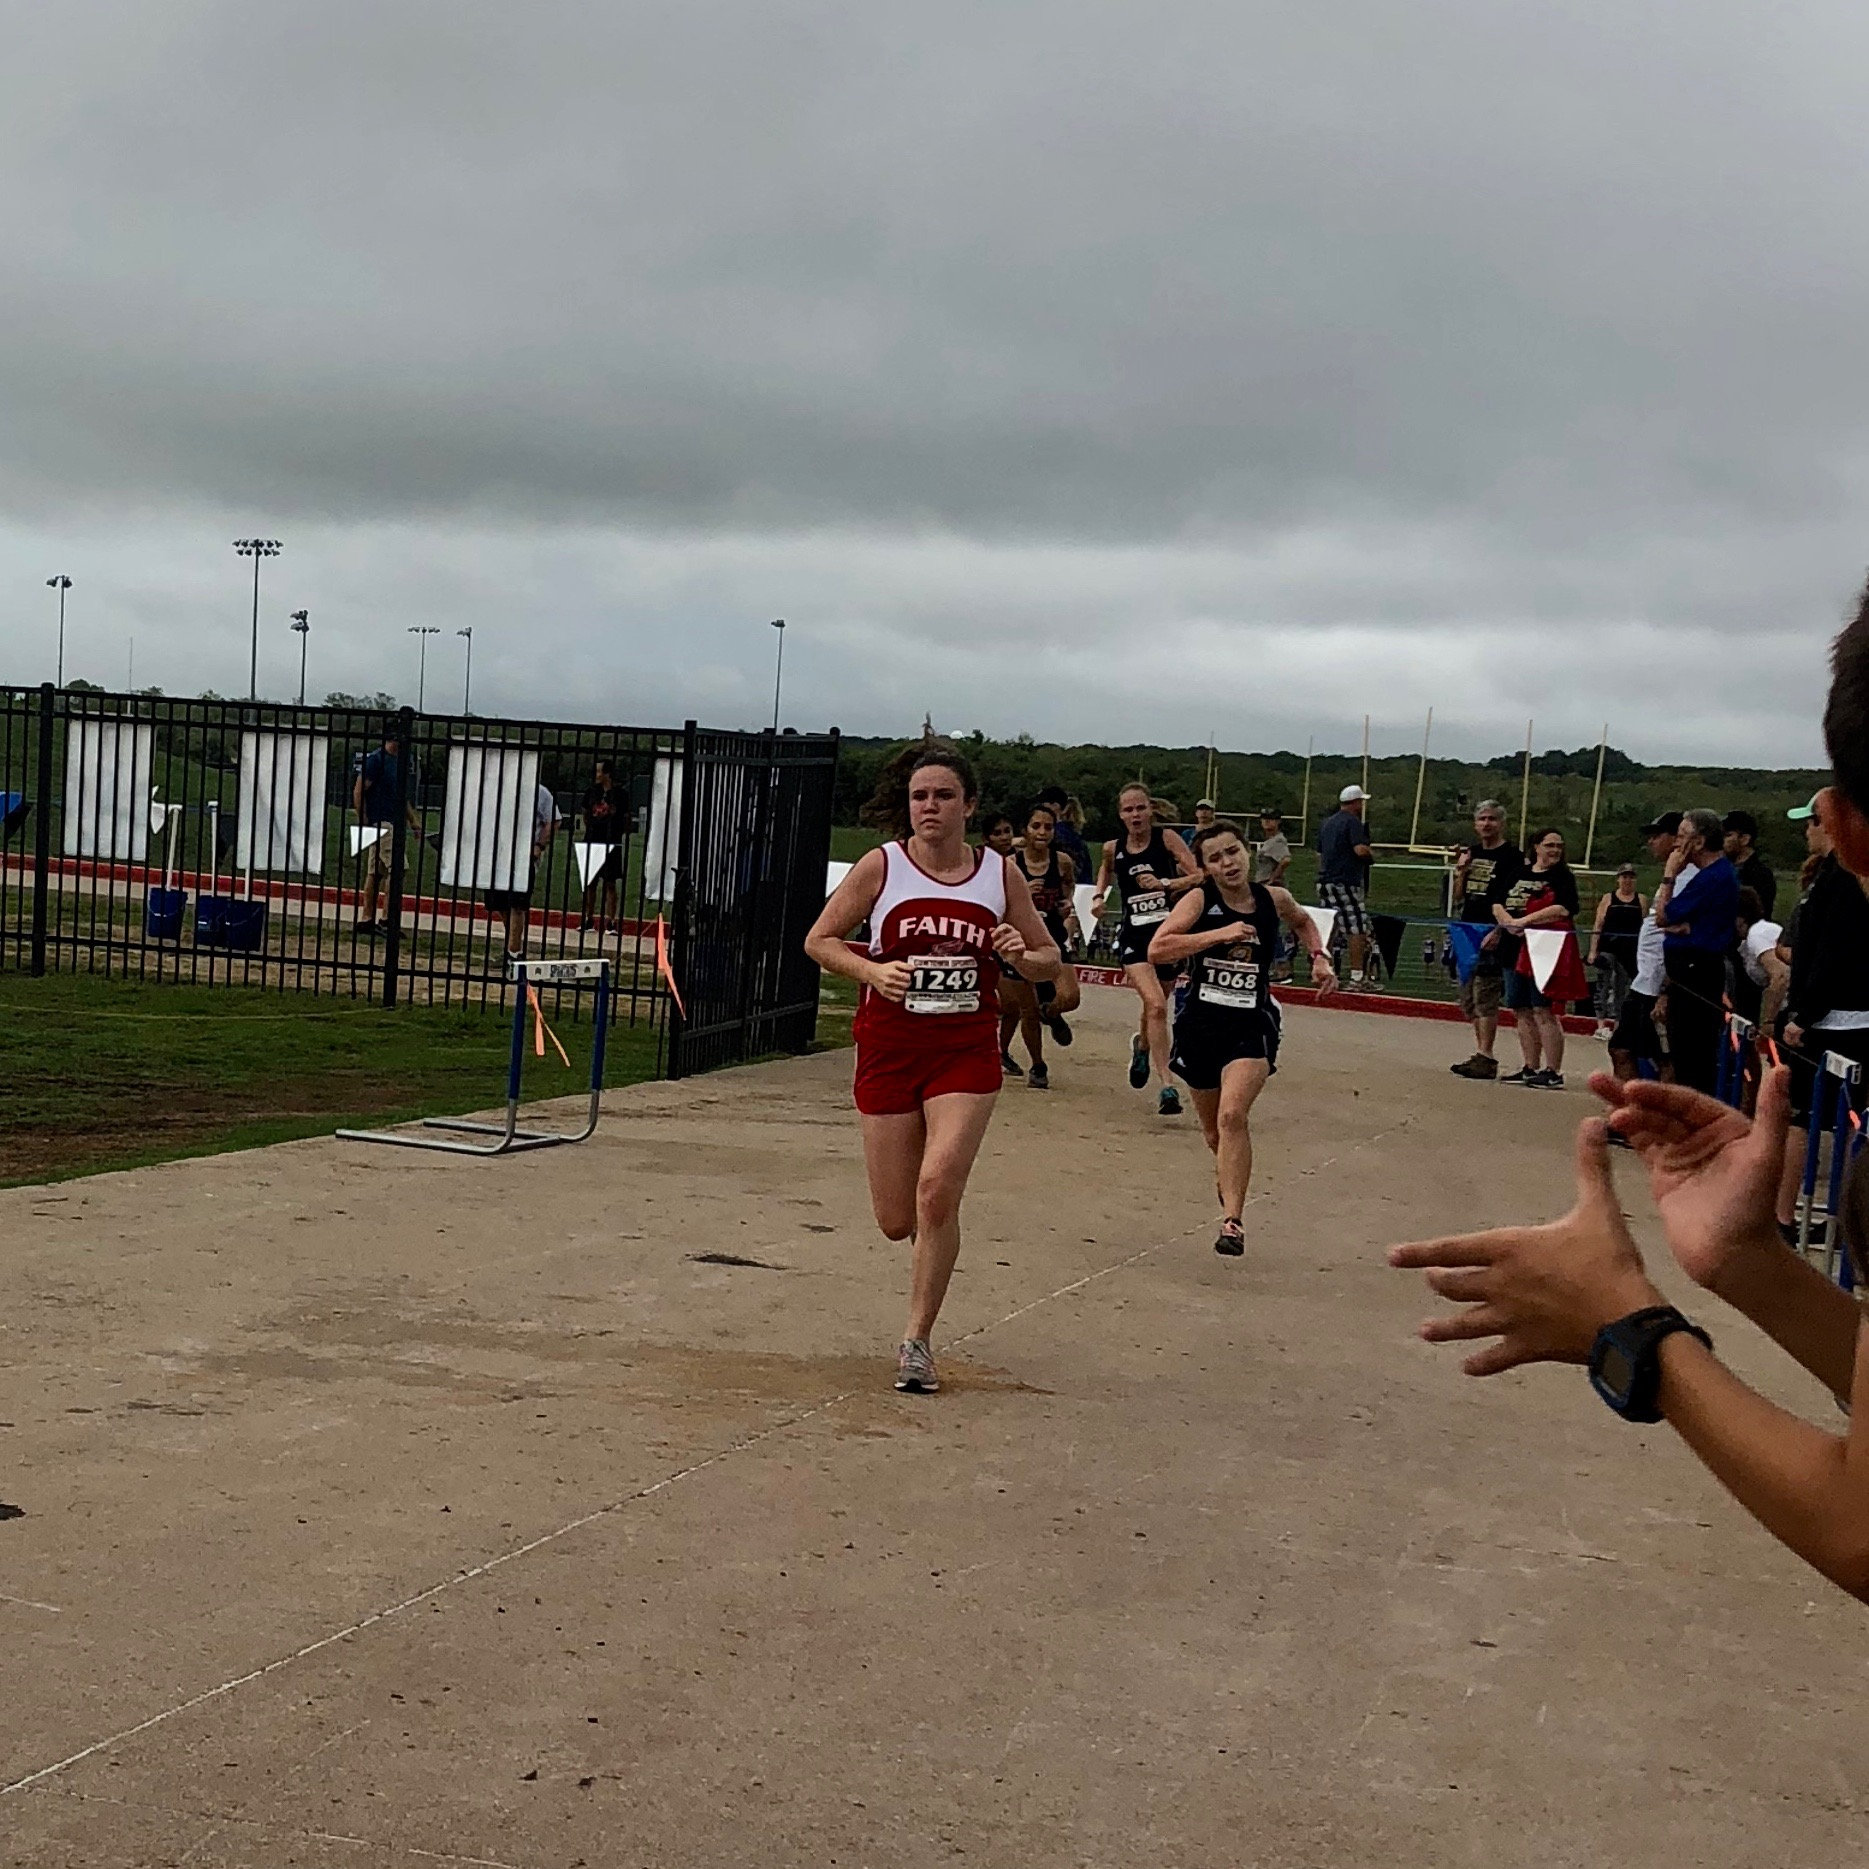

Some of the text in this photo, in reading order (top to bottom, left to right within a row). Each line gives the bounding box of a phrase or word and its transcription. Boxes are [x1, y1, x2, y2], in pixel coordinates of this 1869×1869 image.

[1131, 897, 1166, 914] 1069
[899, 915, 986, 948] FAITH
[913, 969, 978, 991] 1249
[1079, 969, 1107, 985] FIRE
[1206, 968, 1258, 990] 1068
